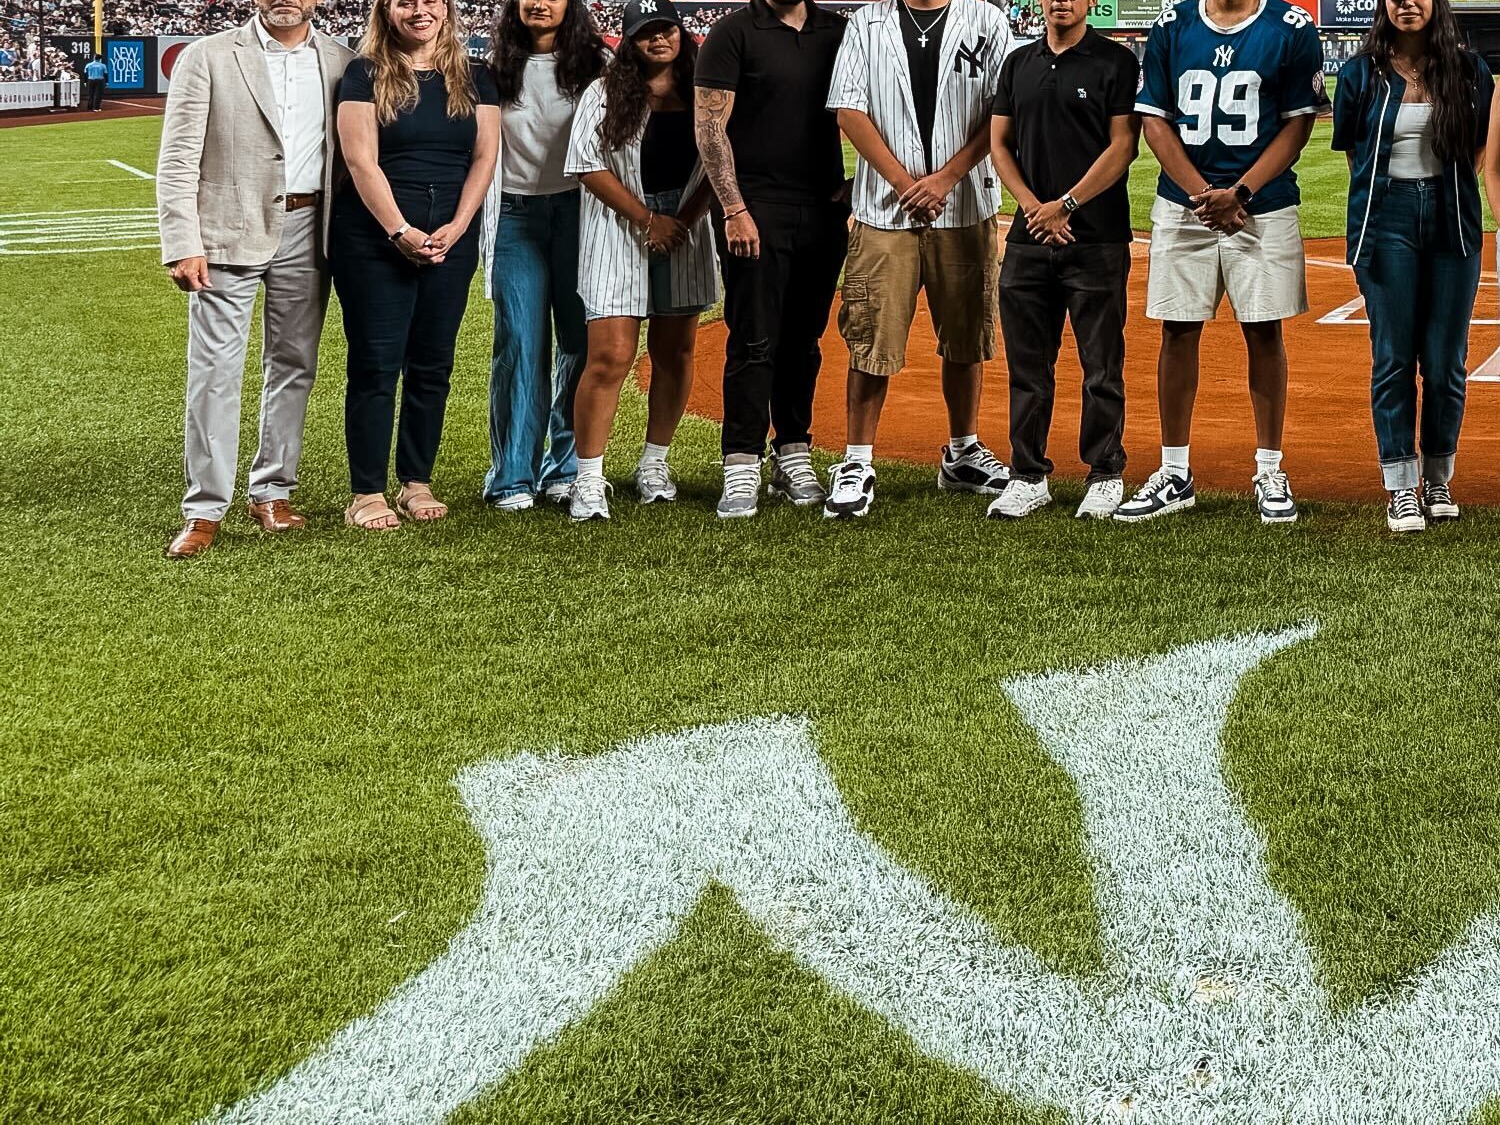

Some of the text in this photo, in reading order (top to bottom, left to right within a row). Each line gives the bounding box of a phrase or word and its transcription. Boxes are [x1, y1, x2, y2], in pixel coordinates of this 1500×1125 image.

[71, 41, 91, 54] 318
[113, 46, 138, 59] NEW
[954, 35, 987, 79] NY
[1213, 44, 1235, 68] NY
[110, 58, 142, 72] YORK
[1323, 61, 1346, 72] TA
[113, 70, 138, 83] LIFE
[1177, 69, 1263, 146] 99
